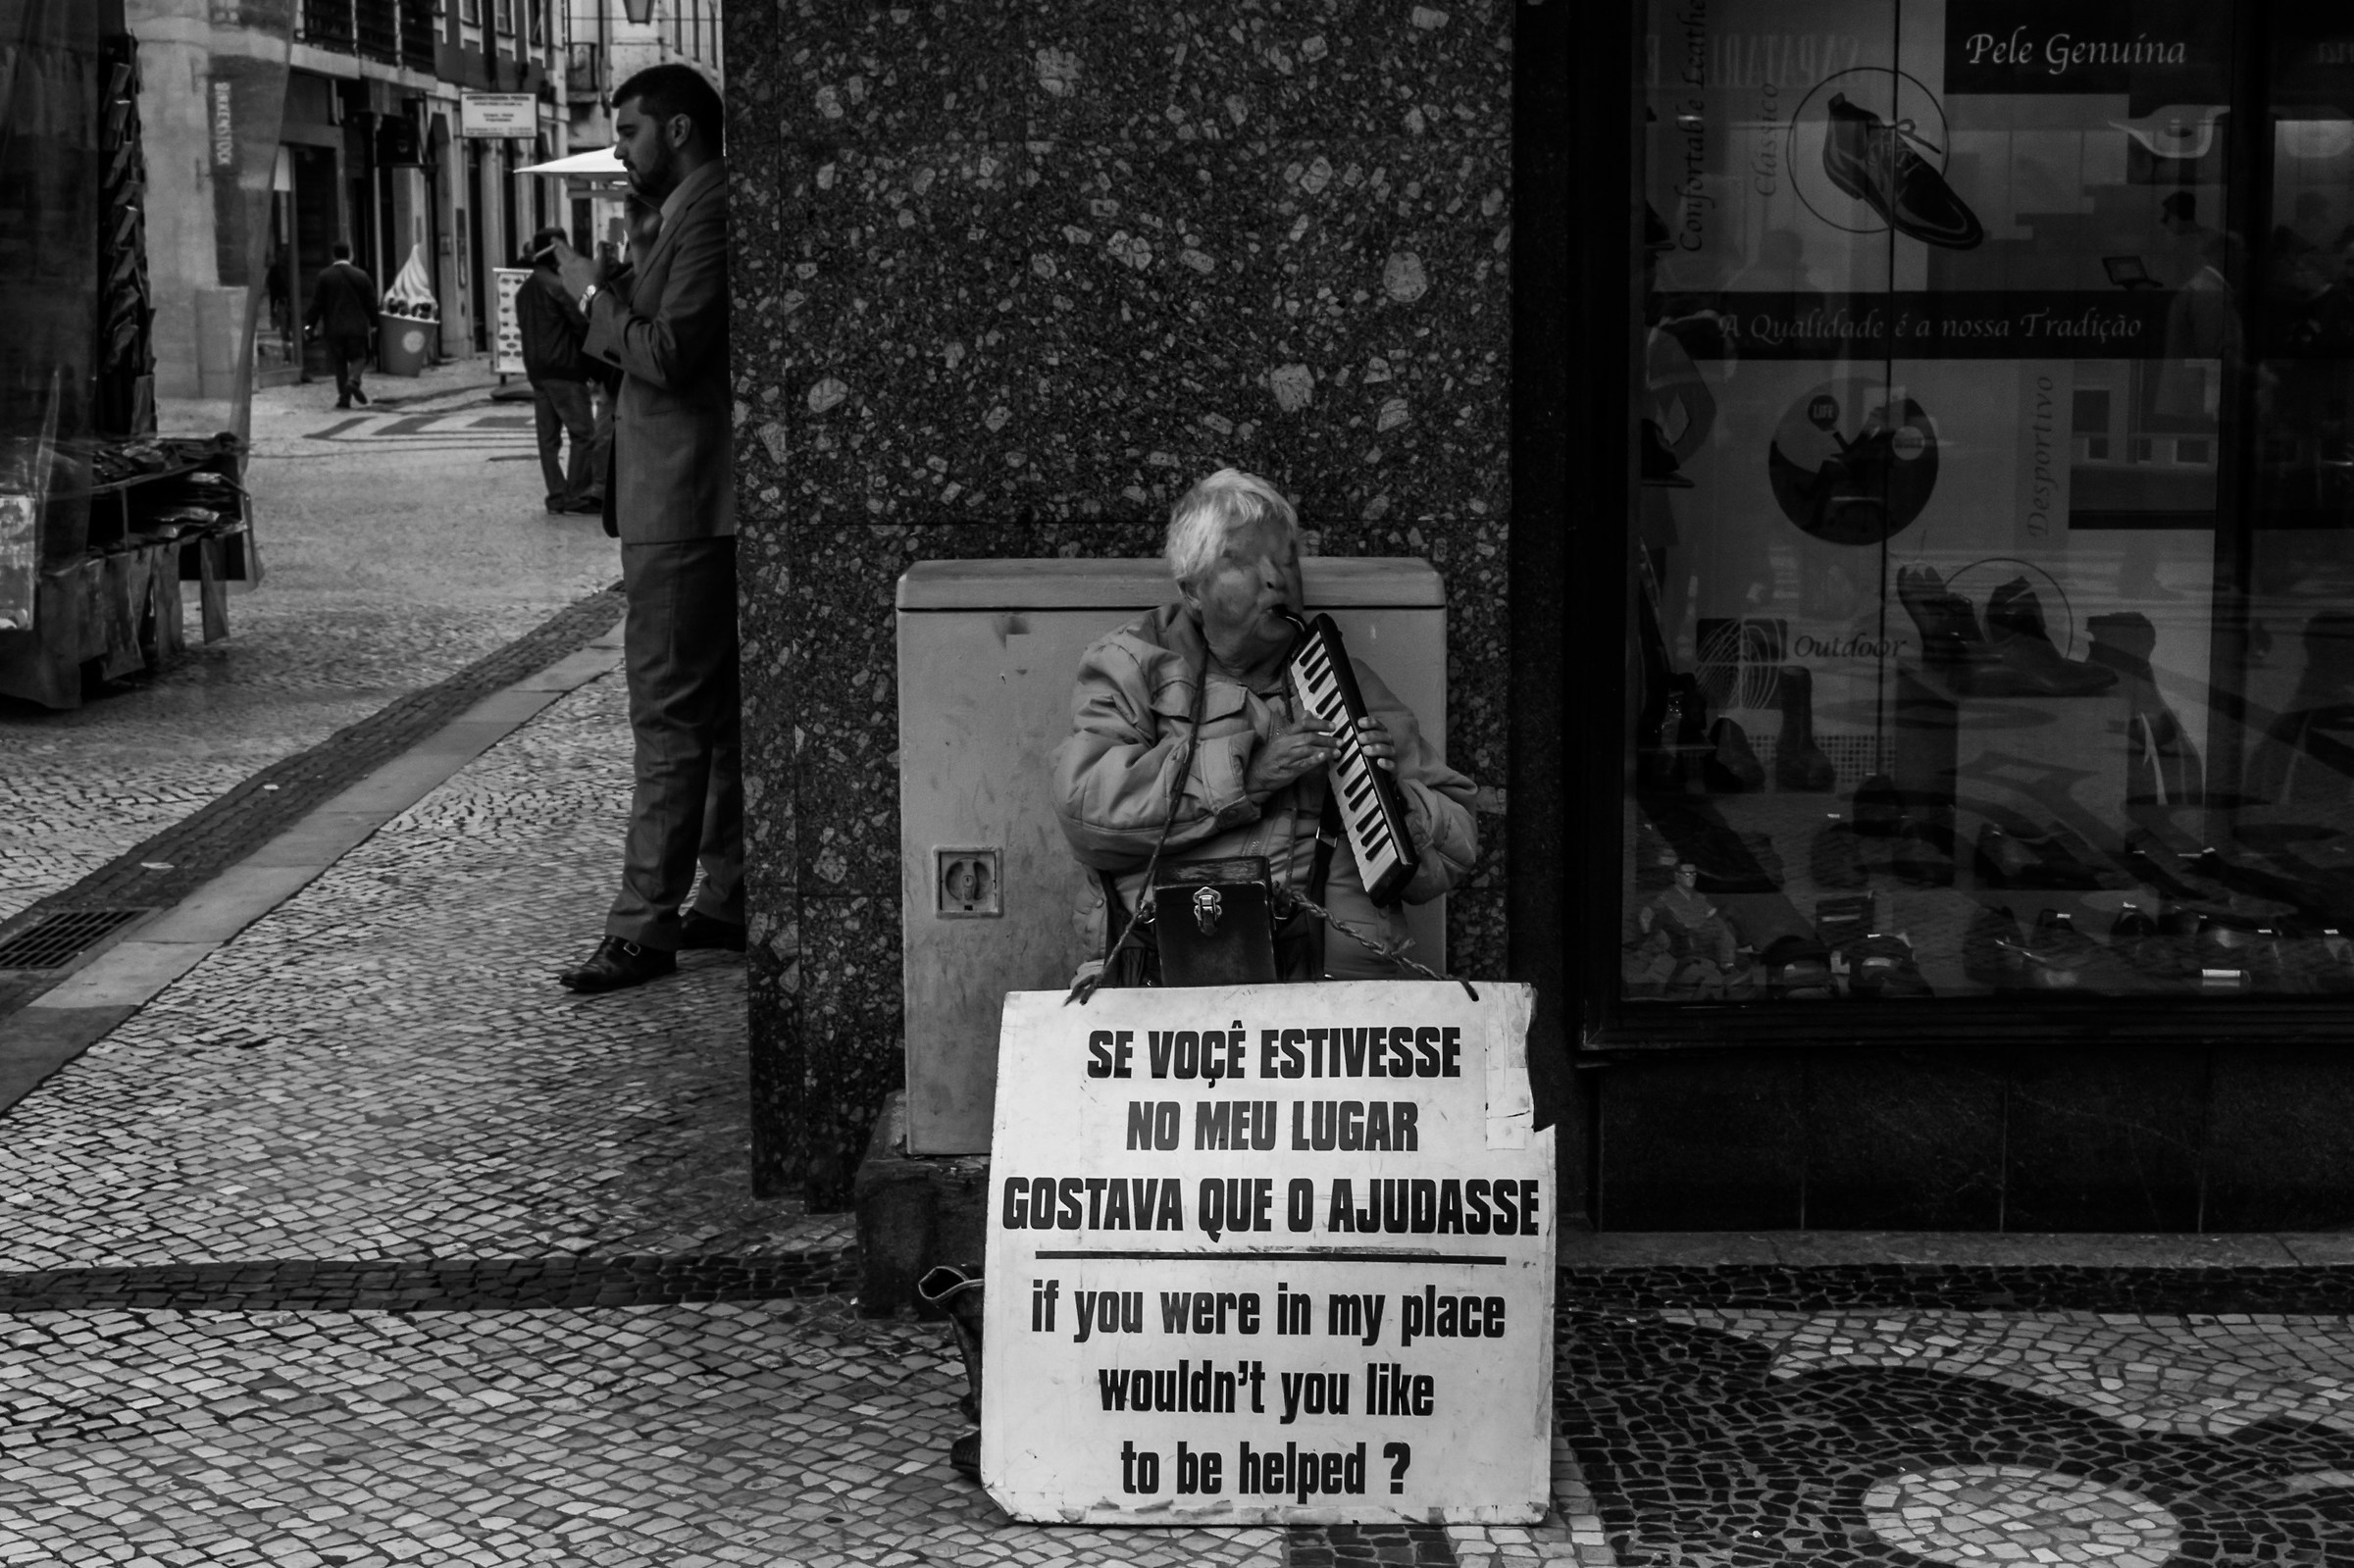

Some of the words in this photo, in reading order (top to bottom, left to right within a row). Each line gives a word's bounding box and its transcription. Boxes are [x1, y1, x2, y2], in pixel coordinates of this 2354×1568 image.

[1966, 26, 2033, 64] Pele
[2045, 34, 2187, 76] Genuína
[1673, 99, 1716, 253] Confortable
[1718, 314, 1741, 337] A
[1750, 307, 1884, 345] Qualidade
[1894, 313, 1909, 337] é
[1915, 320, 1930, 337] a
[1942, 320, 2010, 337] nossa
[2020, 307, 2142, 343] Tradição
[1812, 403, 1834, 420] LIFE
[2025, 375, 2059, 538] Desportivo
[1794, 632, 1907, 658] Outdoor
[1087, 1031, 1133, 1079] SE
[1149, 1020, 1246, 1088] VOÇÊ
[1260, 1027, 1460, 1079] ESTIVESSE
[1127, 1101, 1180, 1150] NO
[1195, 1101, 1277, 1150] MEU
[1292, 1101, 1418, 1151] LUGAR
[1002, 1178, 1183, 1231] GOSTAVA
[1199, 1179, 1272, 1242] QUE
[1288, 1179, 1313, 1232] O
[1328, 1179, 1539, 1236] AJUDASSE
[1032, 1280, 1058, 1332] if
[1074, 1291, 1143, 1342] you
[1160, 1292, 1259, 1335] were
[1278, 1283, 1310, 1335] in
[1329, 1294, 1385, 1346] my
[1402, 1285, 1505, 1346] place
[1099, 1360, 1265, 1413] wouldn't
[1280, 1373, 1350, 1424] you
[1366, 1363, 1434, 1416] like
[1121, 1442, 1159, 1493] to
[1177, 1442, 1221, 1494] be
[1240, 1442, 1365, 1503] helped
[1384, 1442, 1410, 1493] ?
